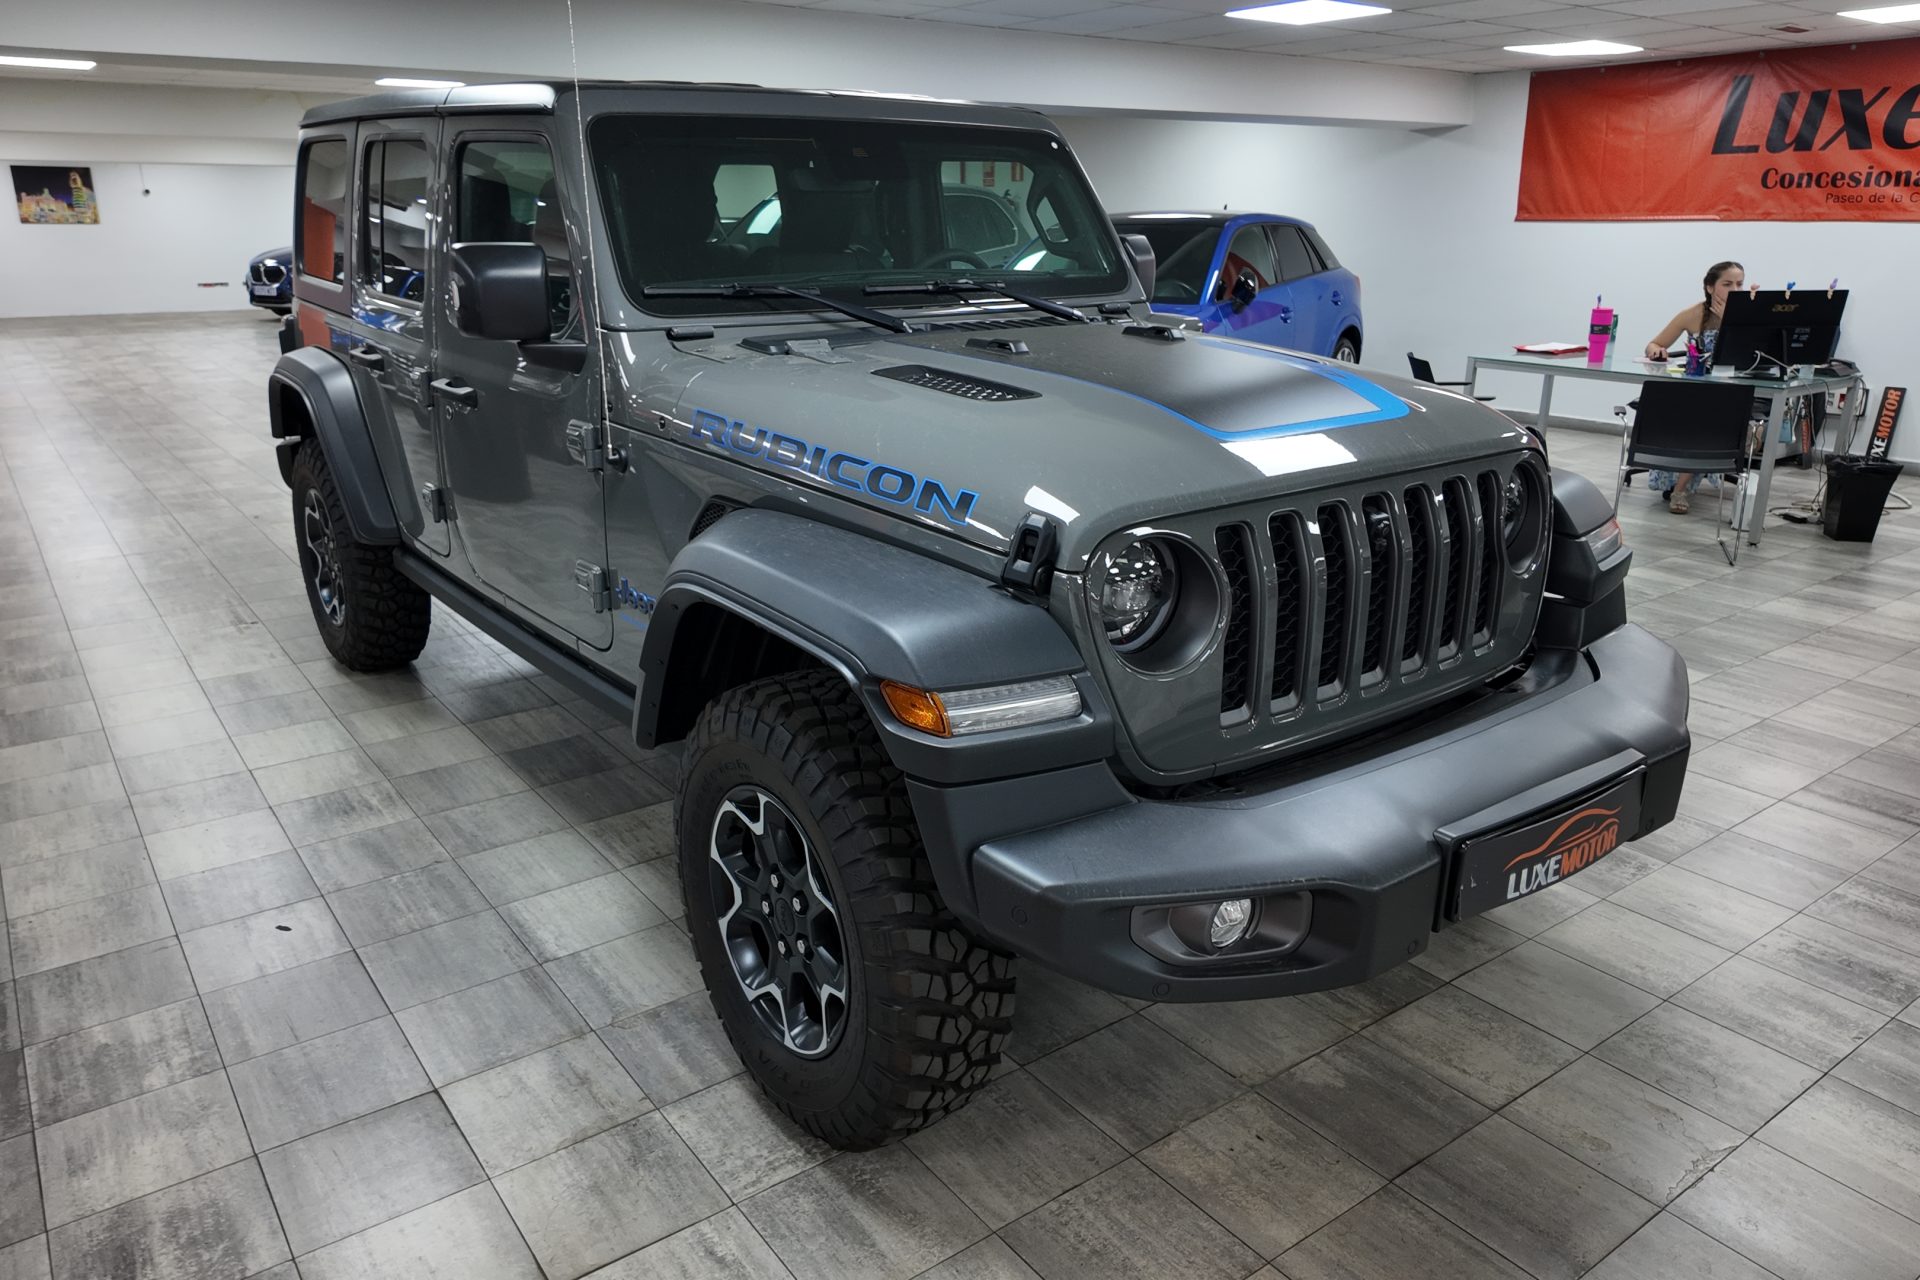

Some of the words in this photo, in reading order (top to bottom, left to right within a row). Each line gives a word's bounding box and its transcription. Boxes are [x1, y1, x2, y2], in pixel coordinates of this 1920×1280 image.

[1711, 74, 1920, 155] Luxe
[1825, 192, 1863, 204] Paseo
[1868, 192, 1886, 203] de
[1890, 192, 1903, 203] la
[1771, 304, 1800, 312] acer
[1870, 389, 1901, 459] XEMOTOR
[691, 408, 980, 525] RUBICON
[1506, 824, 1619, 899] LUXEMOTOR
